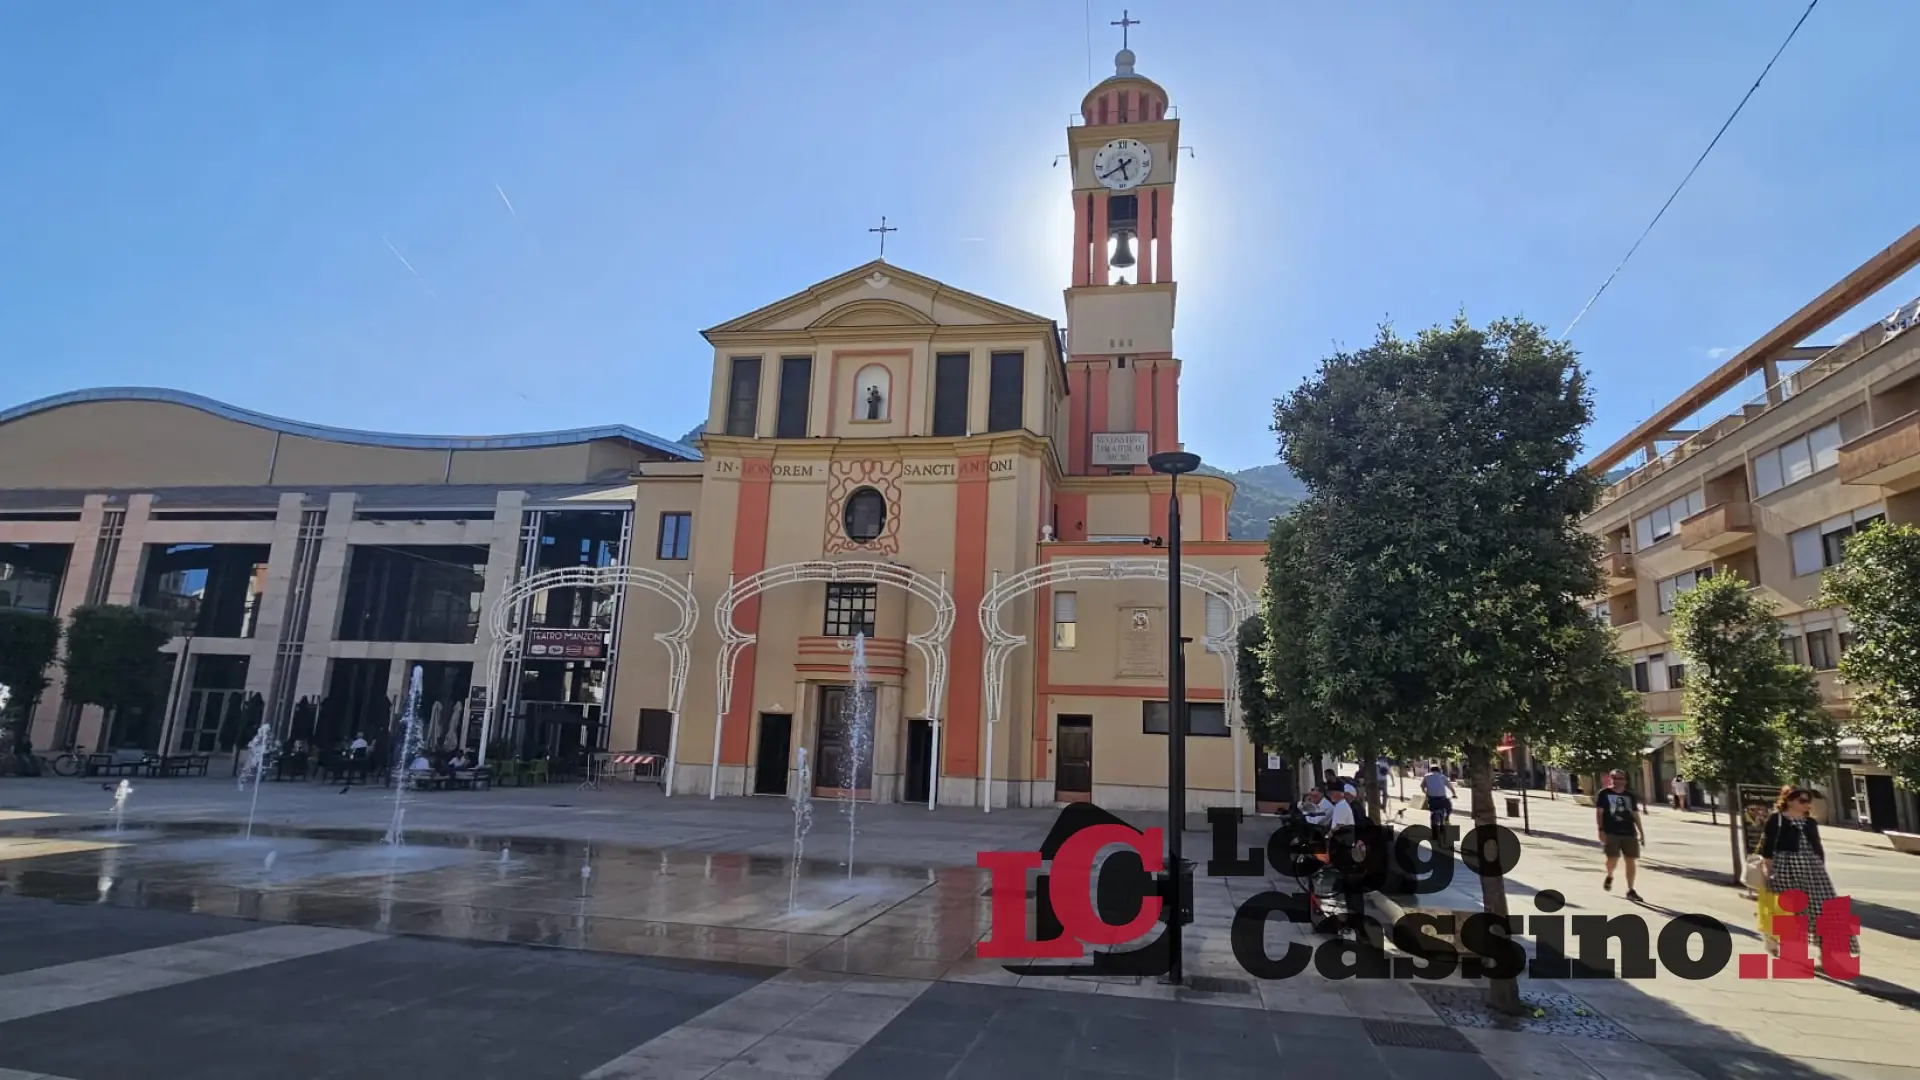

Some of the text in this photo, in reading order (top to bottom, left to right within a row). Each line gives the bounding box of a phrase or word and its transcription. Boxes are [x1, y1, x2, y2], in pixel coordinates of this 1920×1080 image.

[716, 461, 734, 472] IN
[903, 464, 956, 476] SANCTI
[533, 631, 563, 640] TEATRO
